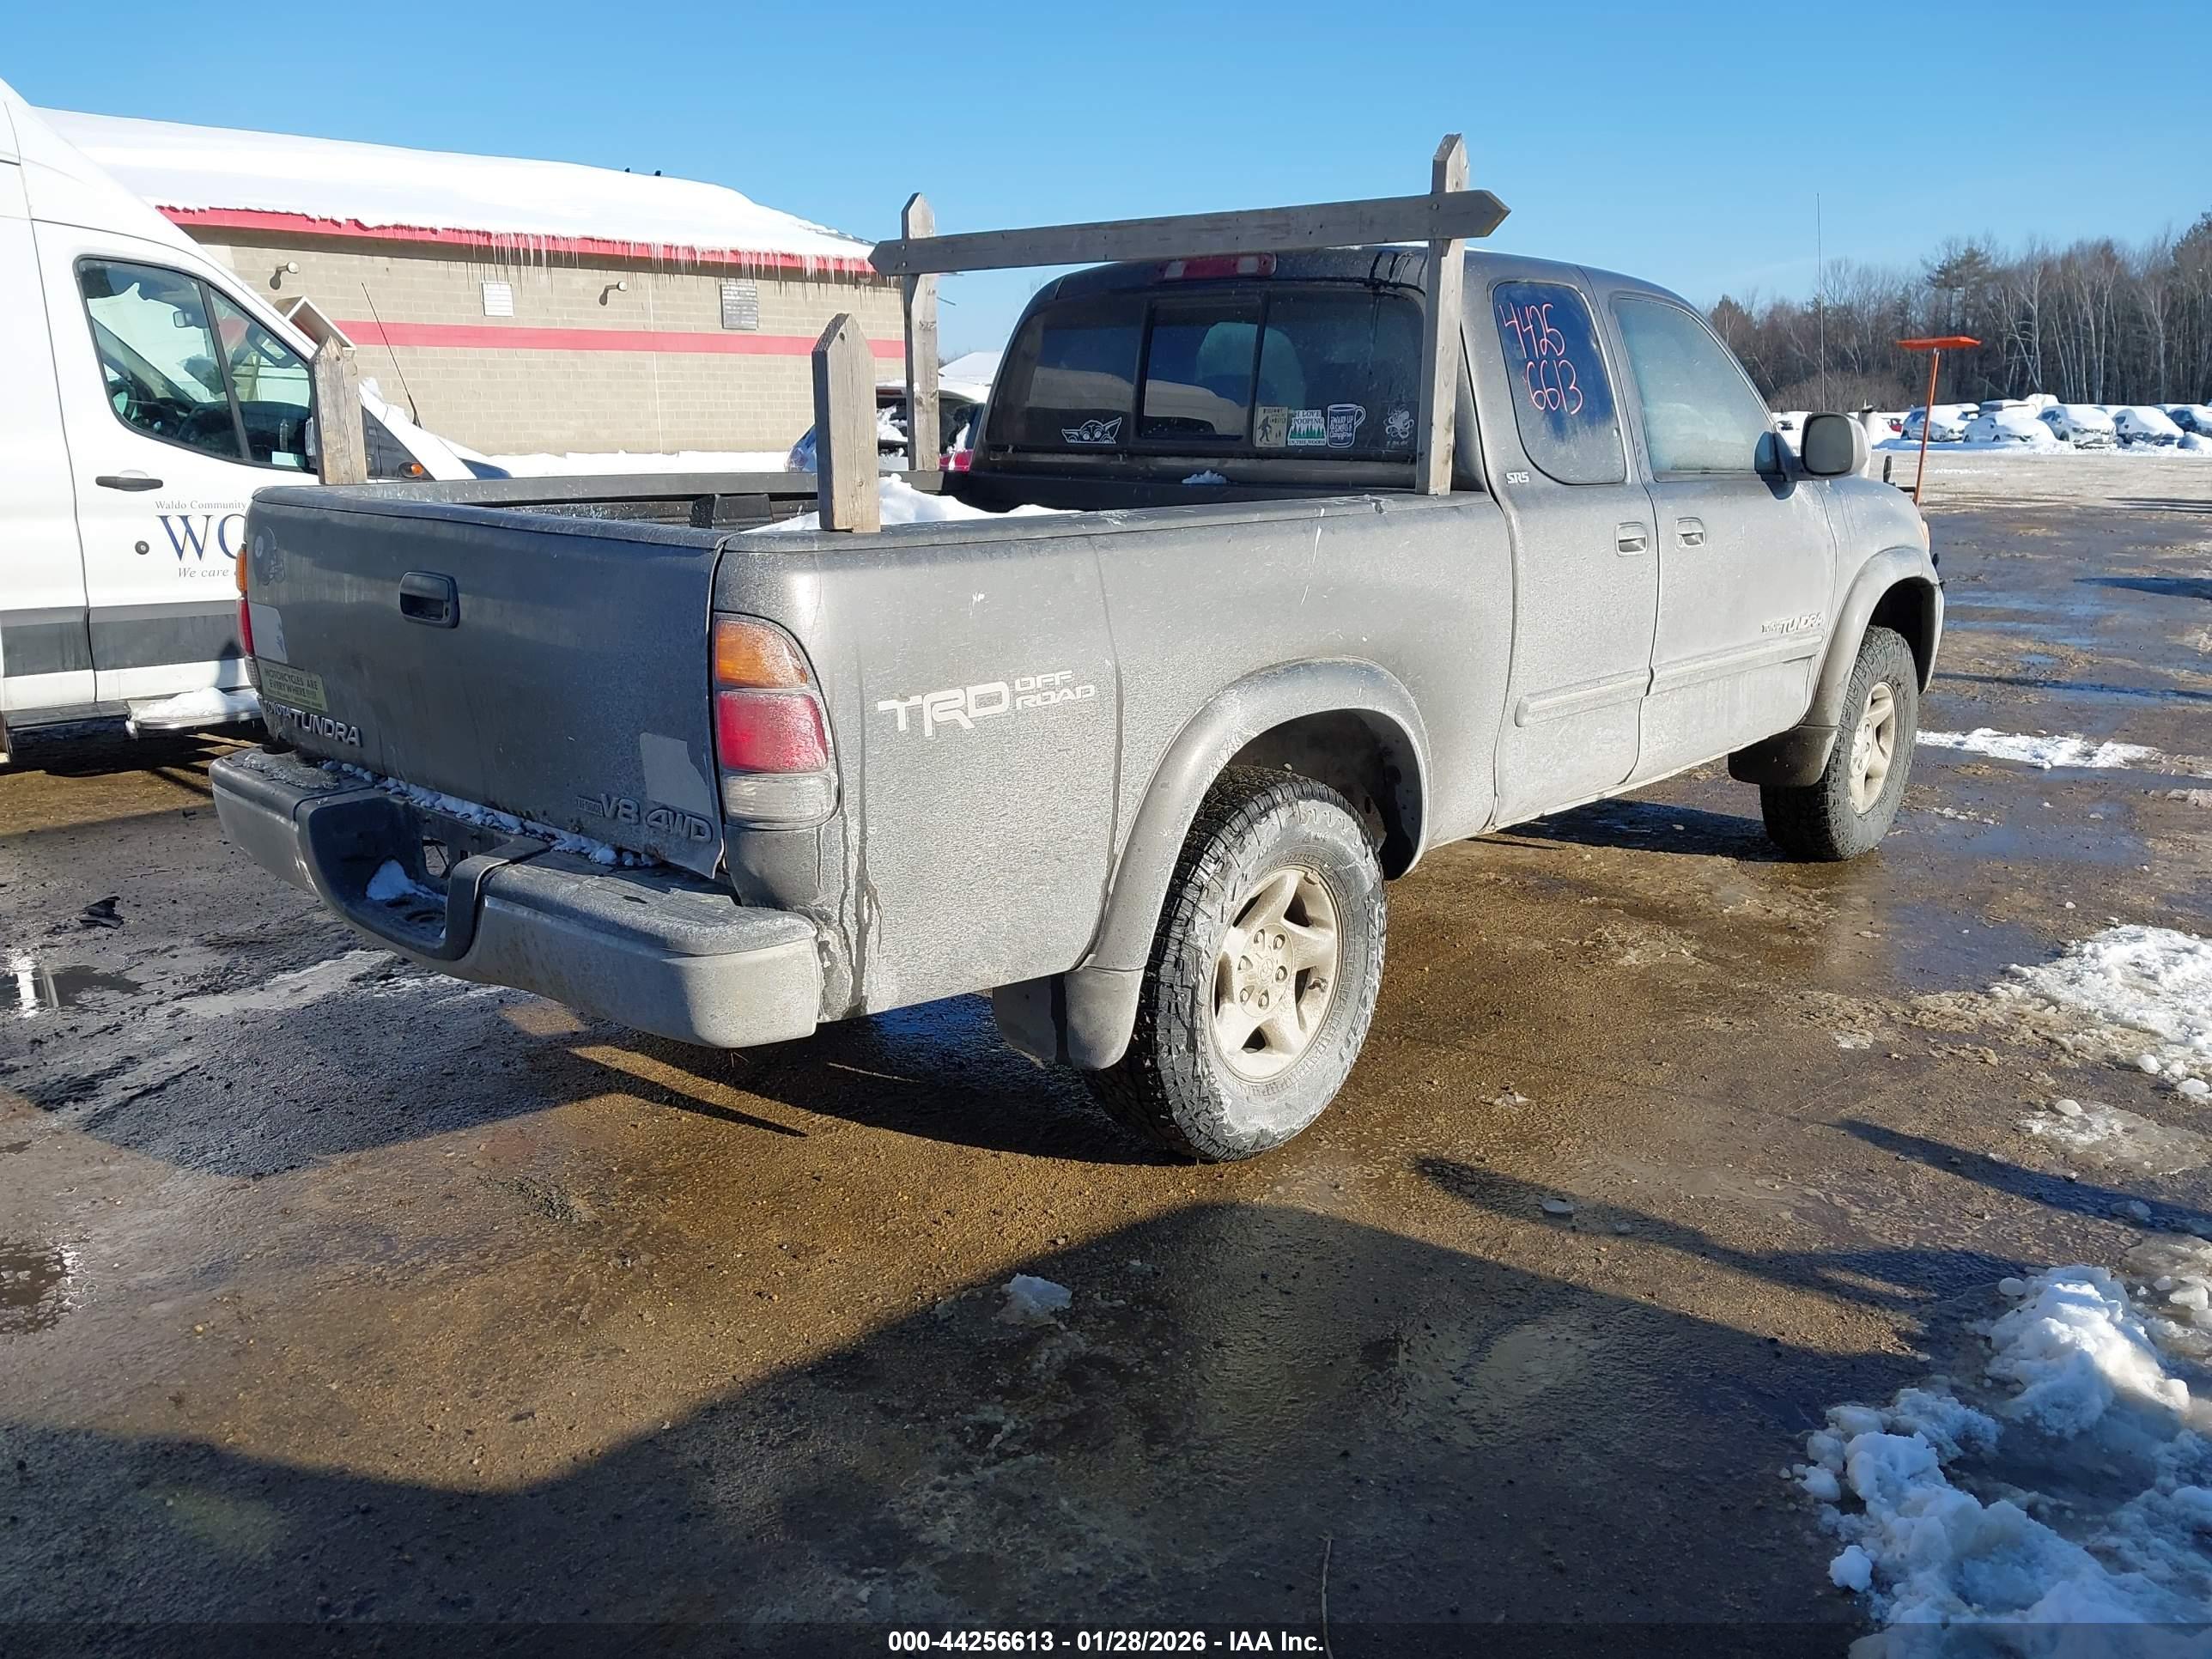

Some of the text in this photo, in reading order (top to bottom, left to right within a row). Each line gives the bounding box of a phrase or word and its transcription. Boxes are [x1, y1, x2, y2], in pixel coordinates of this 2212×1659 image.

[1498, 301, 1565, 359] 4425
[1525, 359, 1583, 415] 6613
[155, 501, 246, 512] Waldo Community
[179, 568, 197, 578] We
[201, 569, 229, 578] care
[264, 668, 319, 690] MOTORCYCLES ARE
[1015, 670, 1073, 691] OFF
[1016, 684, 1096, 710] ROAD
[264, 700, 362, 747] TOYOTA TUNDRA
[877, 681, 1010, 737] TRD
[601, 793, 641, 825] V8
[646, 808, 713, 842] 4WD
